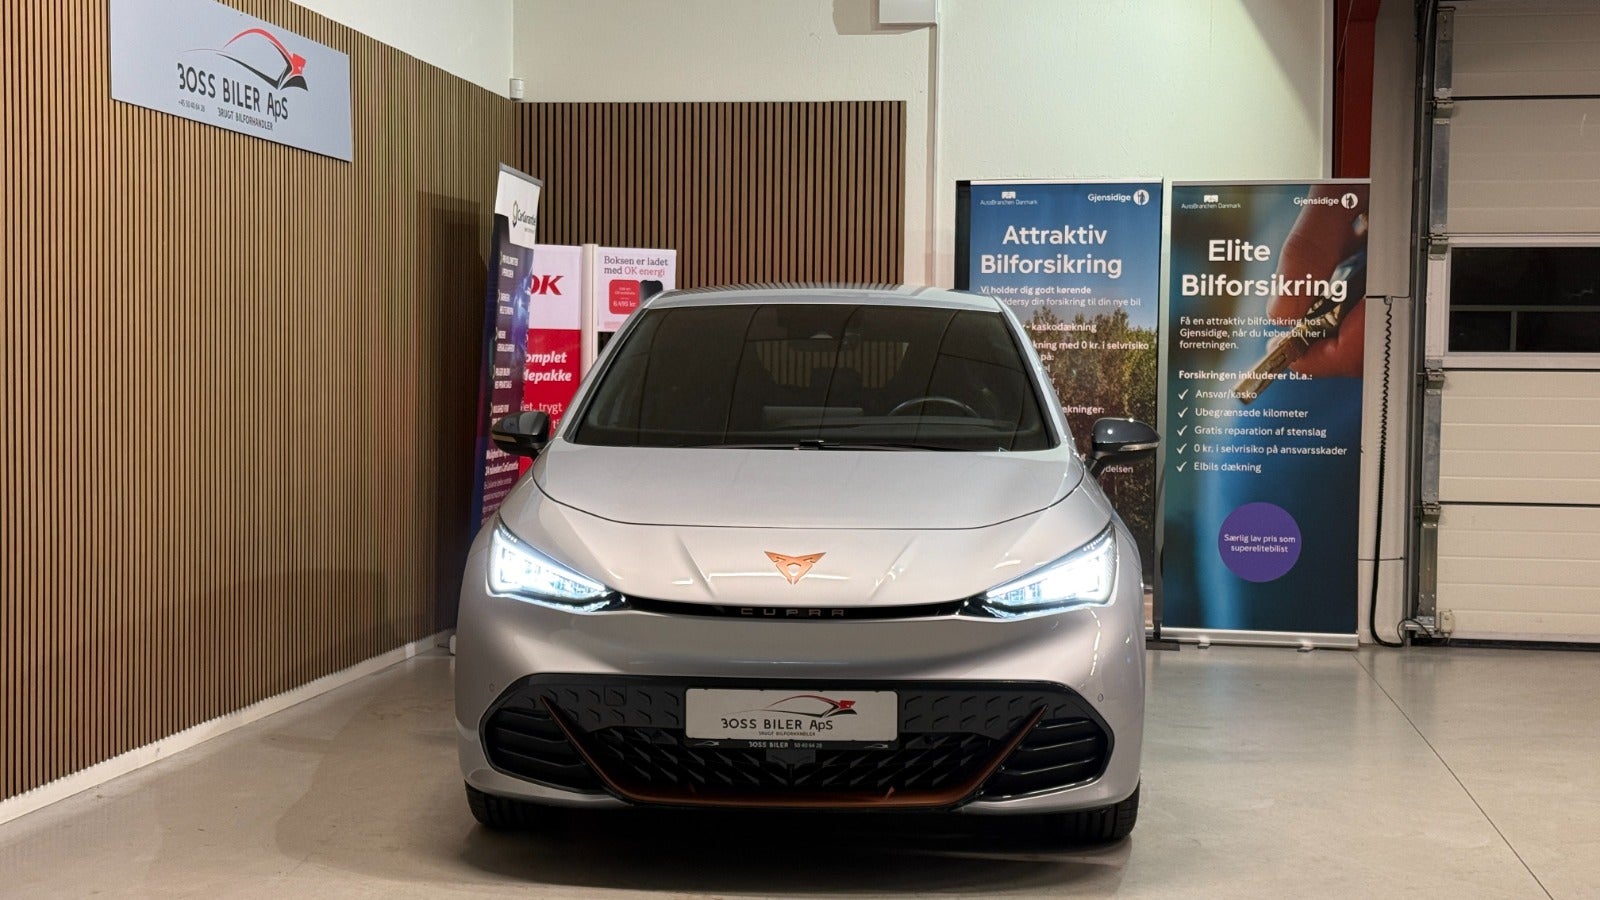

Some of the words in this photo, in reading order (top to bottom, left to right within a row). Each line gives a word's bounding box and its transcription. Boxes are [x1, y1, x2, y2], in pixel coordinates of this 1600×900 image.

[222, 77, 261, 113] BILER
[266, 91, 289, 123] ApS
[235, 112, 273, 131] BILFORHANDLER
[1088, 193, 1131, 203] Gjensidige
[1293, 197, 1339, 206] Gjensidige
[1002, 224, 1108, 245] Attraktiv
[1208, 239, 1271, 262] Elite
[604, 255, 635, 265] Boksen
[636, 258, 645, 266] er
[647, 257, 668, 266] ladet
[980, 254, 1122, 279] Bilforsikring
[604, 266, 623, 275] med
[624, 266, 638, 275] OK
[639, 268, 665, 278] energi
[980, 286, 990, 294] Vi
[991, 286, 1018, 294] holder
[1020, 286, 1033, 295] dig
[1035, 286, 1055, 295] godt
[1057, 286, 1092, 294] kørende
[1181, 273, 1348, 303] Bilforsikring
[1031, 298, 1045, 306] din
[1047, 298, 1086, 307] forsikring
[1087, 298, 1097, 306] til
[1098, 298, 1111, 306] din
[1112, 299, 1128, 308] nye
[1130, 298, 1141, 306] bil
[1031, 323, 1097, 333] kaskodækning
[1180, 316, 1191, 326] Få
[1206, 317, 1246, 326] attraktiv
[1248, 317, 1302, 328] bilforsikring
[1304, 317, 1321, 326] hos
[1180, 329, 1231, 339] Gjensidige,
[1232, 328, 1248, 337] når
[1250, 329, 1261, 337] du
[1263, 329, 1291, 338] køber
[1292, 329, 1303, 338] bil
[1305, 329, 1321, 338] her
[1033, 341, 1057, 351] kning
[1059, 341, 1079, 349] med
[1081, 341, 1088, 349] 0
[1089, 341, 1101, 349] kr.
[1106, 341, 1149, 350] selvrisiko
[1179, 340, 1239, 350] forretningen.
[525, 350, 567, 367] omplet
[1040, 352, 1054, 361] på:
[1178, 370, 1236, 382] Forsikringen
[1238, 371, 1287, 381] inkluderer
[1289, 371, 1312, 381] bl.a.:
[1195, 389, 1258, 399] Ansvar/kasko
[538, 402, 563, 415] trygt
[1195, 408, 1261, 419] Ubegrænsede
[1263, 408, 1308, 418] kilometer
[1194, 425, 1223, 435] Gratis
[1224, 426, 1273, 438] reparation
[1274, 426, 1285, 436] af
[1287, 427, 1327, 438] stenslag
[1193, 443, 1200, 453] 0
[1202, 444, 1214, 453] kr.
[1221, 444, 1264, 454] selvrisiko
[1266, 444, 1278, 456] på
[1280, 445, 1348, 456] ansvarsskader
[1194, 462, 1219, 471] Elbils
[1221, 462, 1262, 474] dækning
[1224, 533, 1249, 544] Særlig
[1250, 534, 1261, 543] lav
[1263, 534, 1278, 545] pris
[1230, 544, 1289, 554] superelitebilist
[740, 607, 844, 617] CUPRA
[763, 719, 802, 730] BILER
[809, 720, 833, 732] ApS
